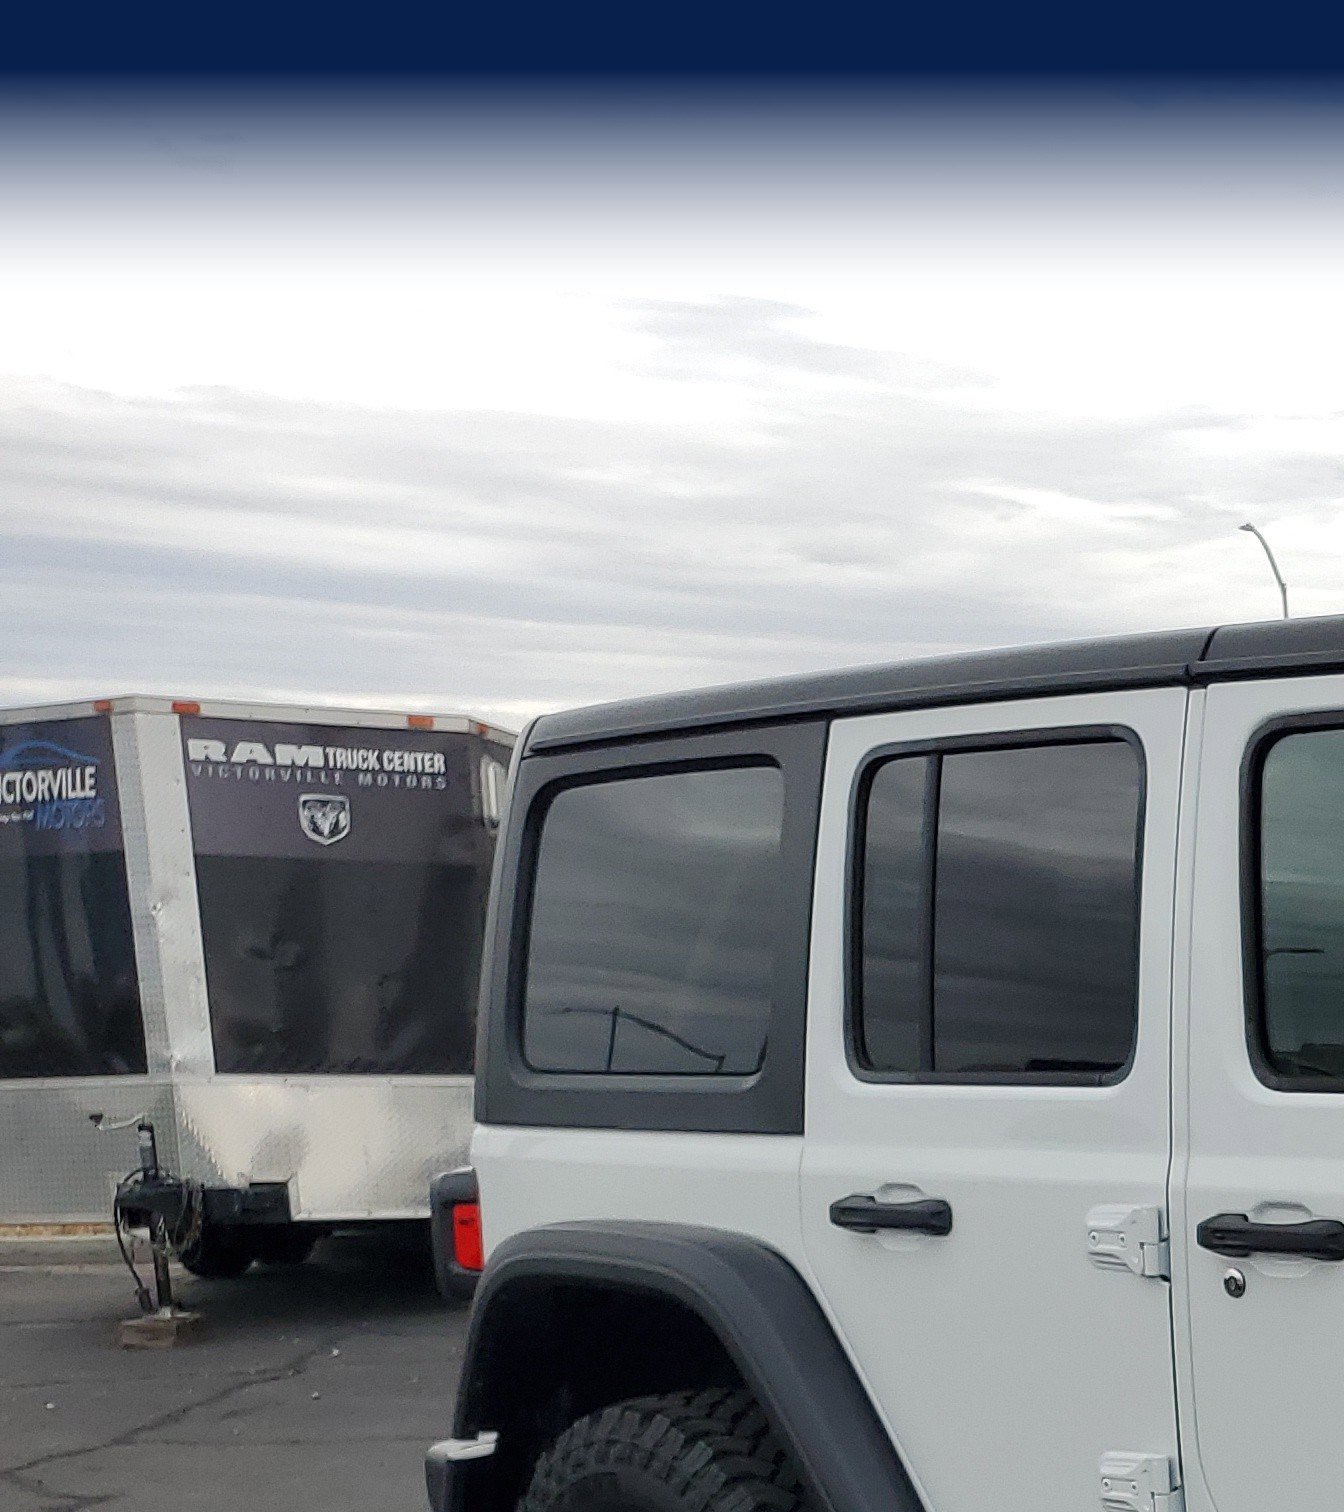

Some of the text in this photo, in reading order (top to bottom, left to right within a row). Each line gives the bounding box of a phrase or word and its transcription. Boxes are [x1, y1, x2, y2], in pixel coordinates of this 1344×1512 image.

[187, 738, 446, 775] RAM TRUCK CENTER
[0, 766, 97, 804] CTORVILLE
[190, 763, 448, 790] VICTORVILLE MOTORS
